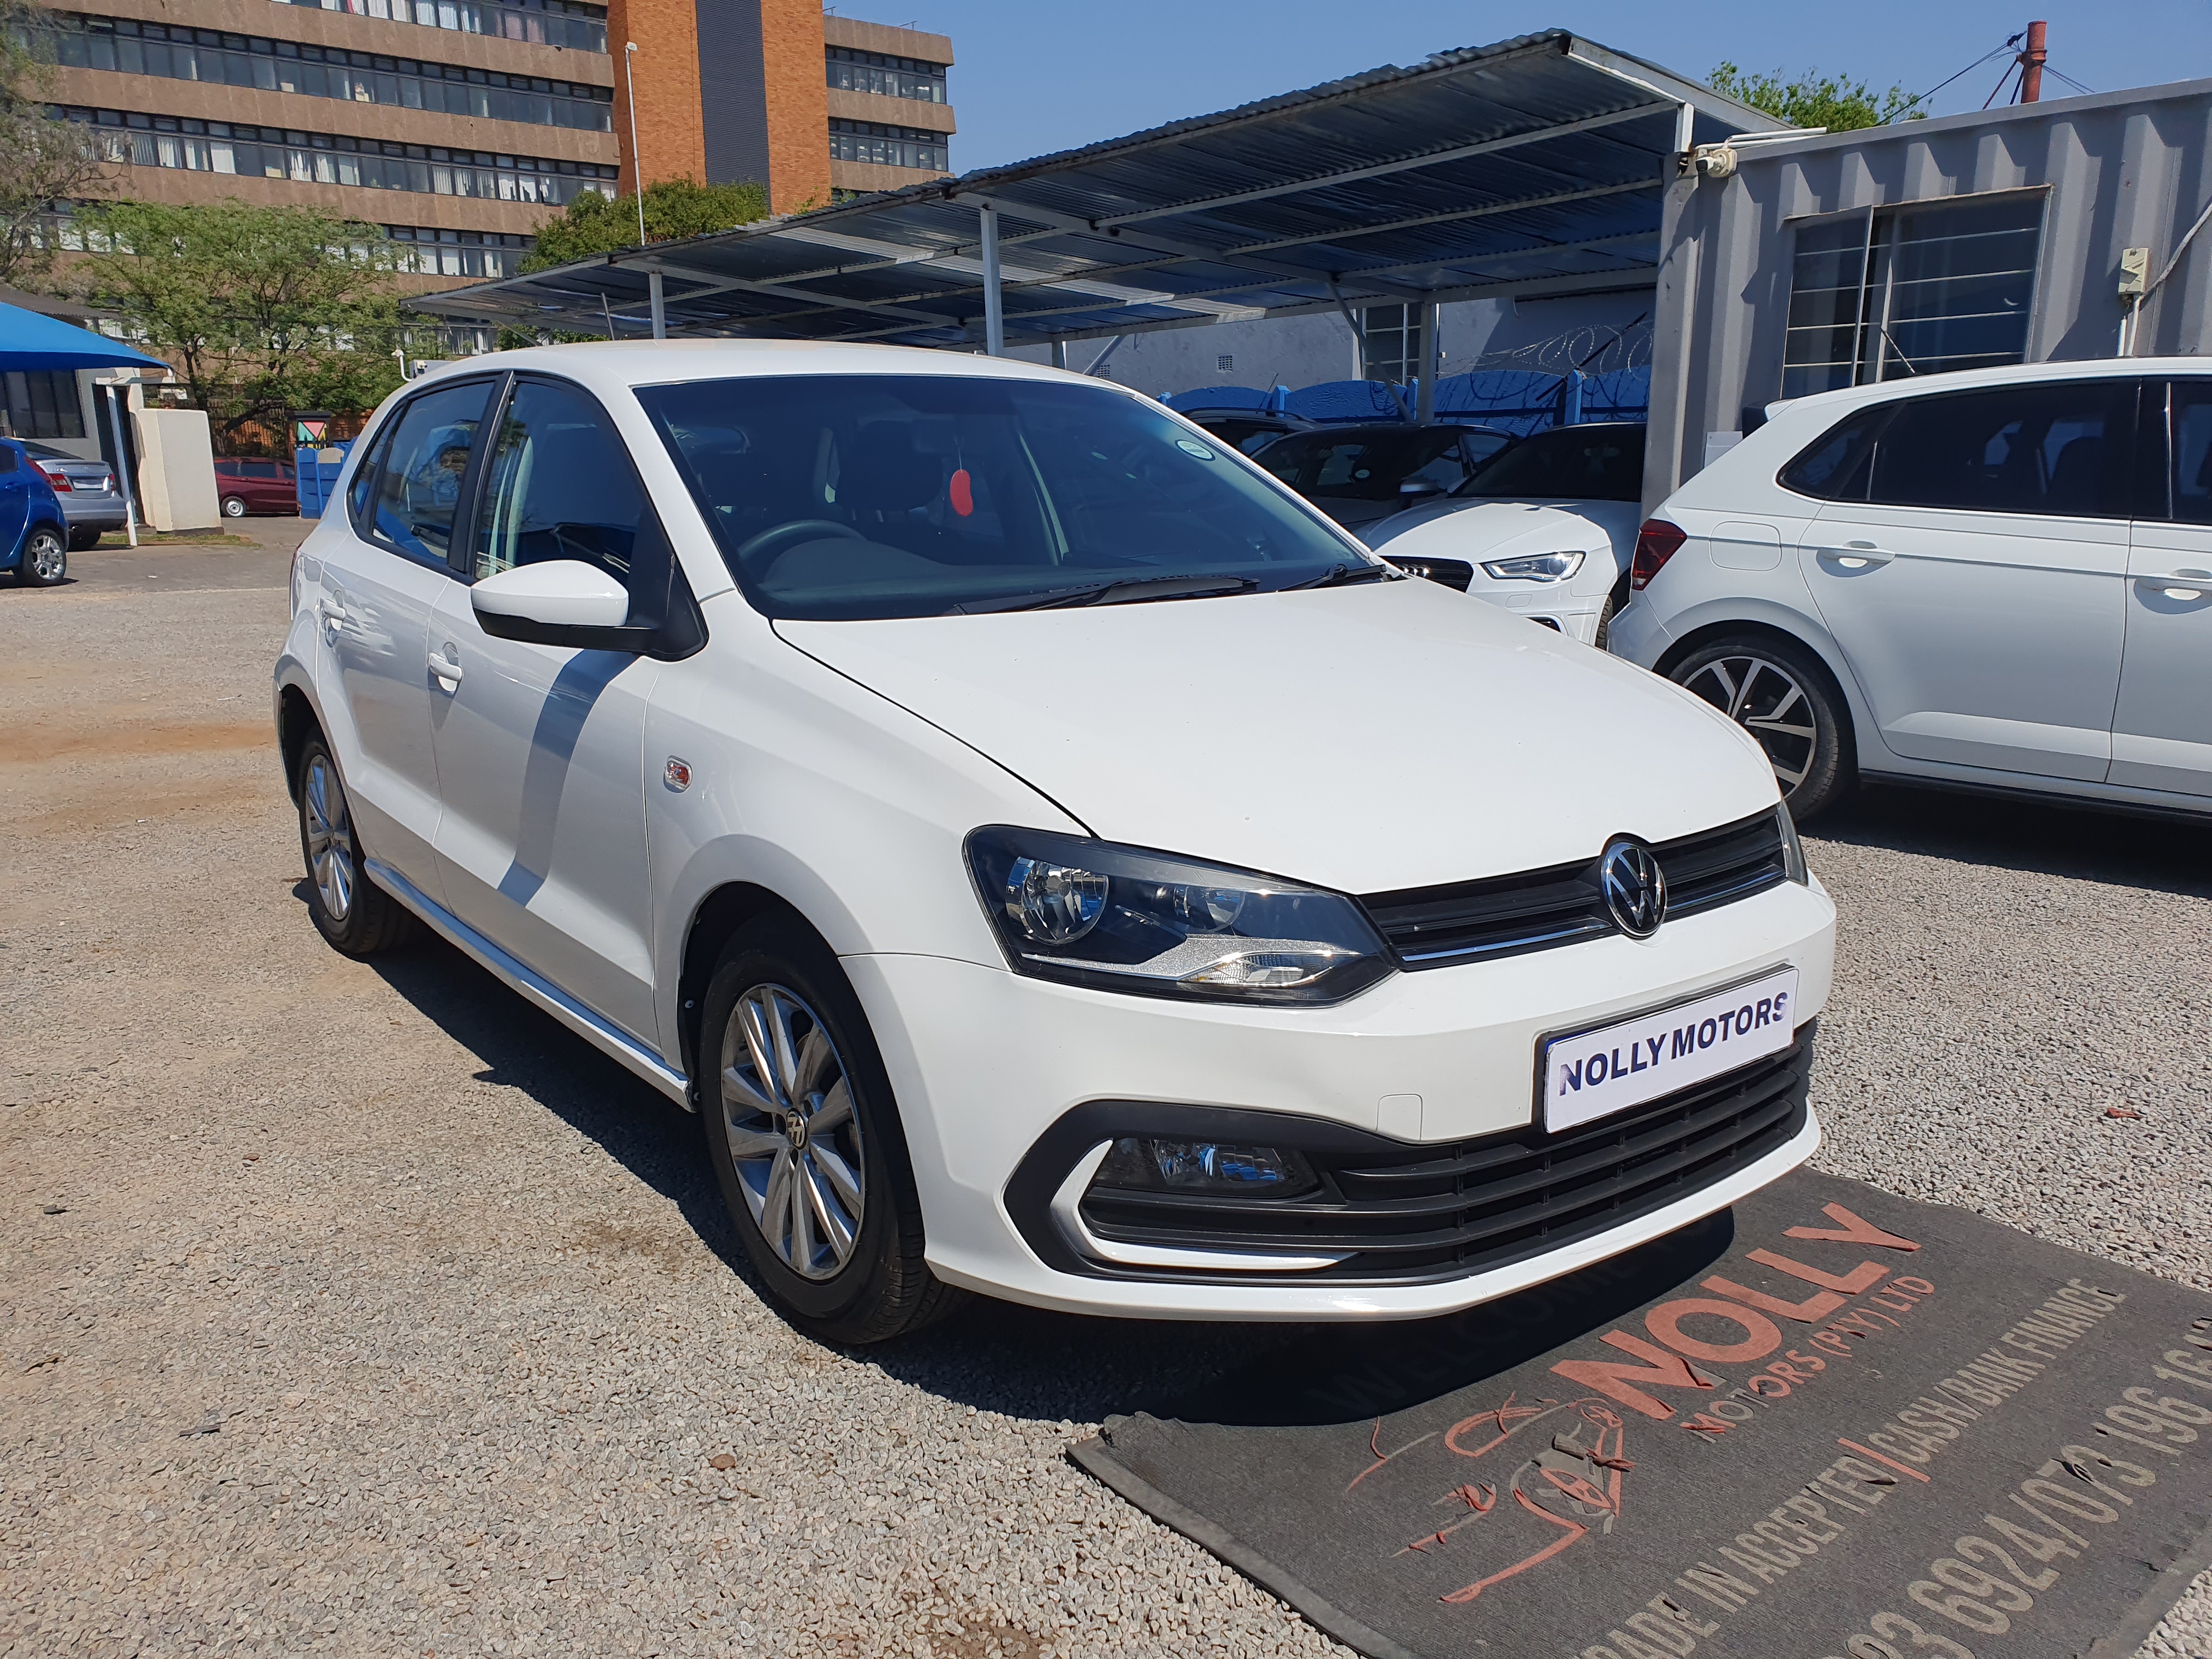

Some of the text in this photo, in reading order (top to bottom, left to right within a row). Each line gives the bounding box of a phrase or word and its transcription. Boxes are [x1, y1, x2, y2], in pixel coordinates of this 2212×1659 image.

[1559, 992, 1787, 1096] NOLLY MOTORS
[1550, 1201, 1921, 1420] NOLLY
[1681, 1350, 1826, 1443] MOTORS
[1870, 1276, 1934, 1312] LTD
[1674, 1561, 1759, 1613] IN
[1718, 1455, 1898, 1584] ACCEPTED
[1868, 1344, 2046, 1463] CASH/BANK
[2000, 1278, 2126, 1359] FINANCE
[2090, 1386, 2212, 1455] 196
